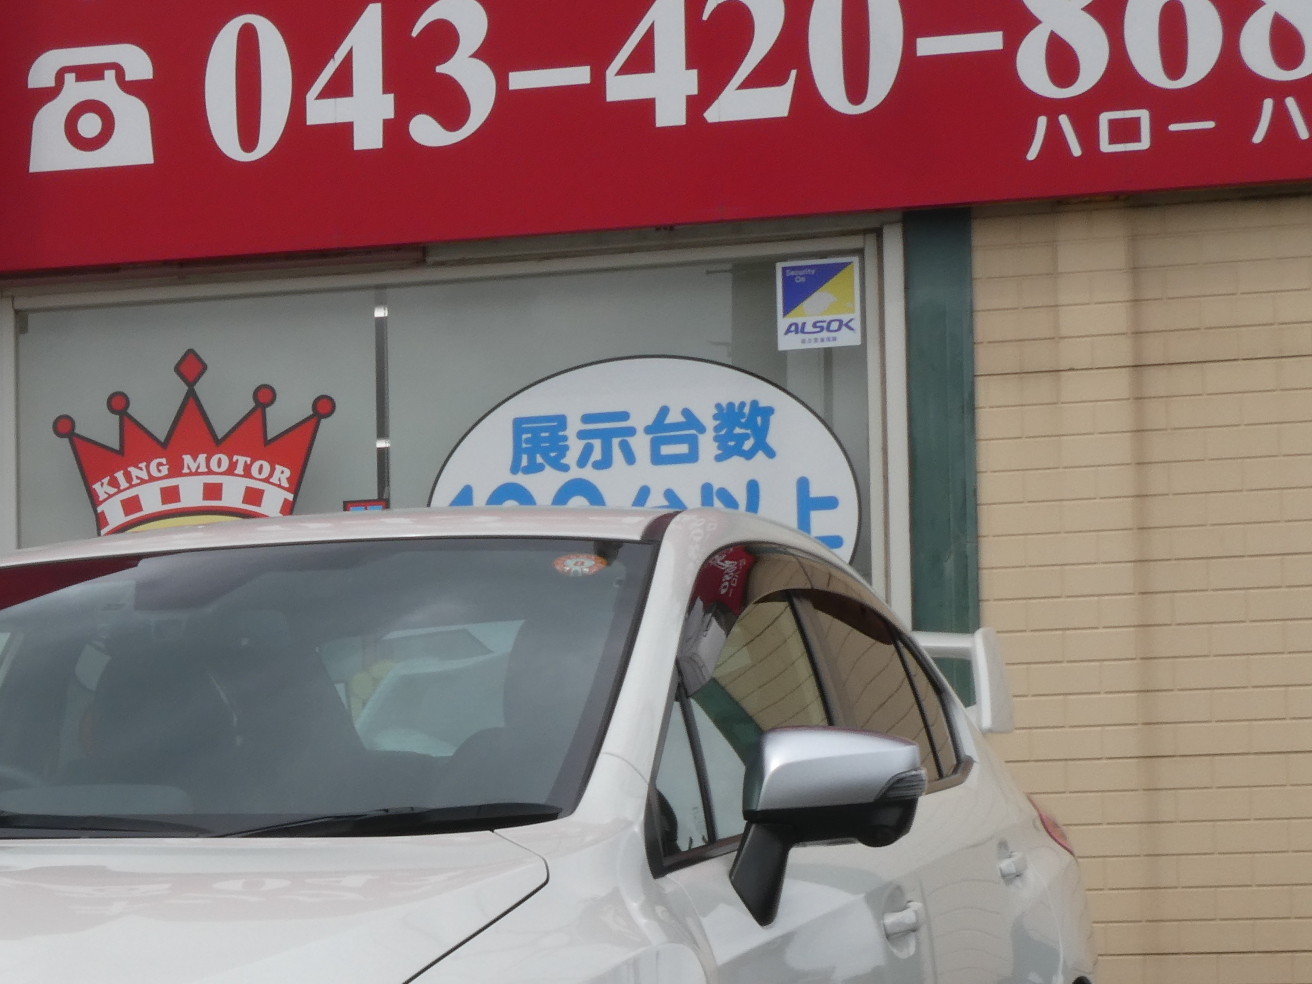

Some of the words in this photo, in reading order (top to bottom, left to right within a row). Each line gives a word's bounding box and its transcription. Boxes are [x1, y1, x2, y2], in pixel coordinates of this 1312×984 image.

[1025, 108, 1216, 161] ハロー
[783, 317, 856, 336] ALSOK
[509, 399, 777, 476] 展示台数
[92, 457, 169, 501] KING
[182, 453, 292, 488] MOTOR
